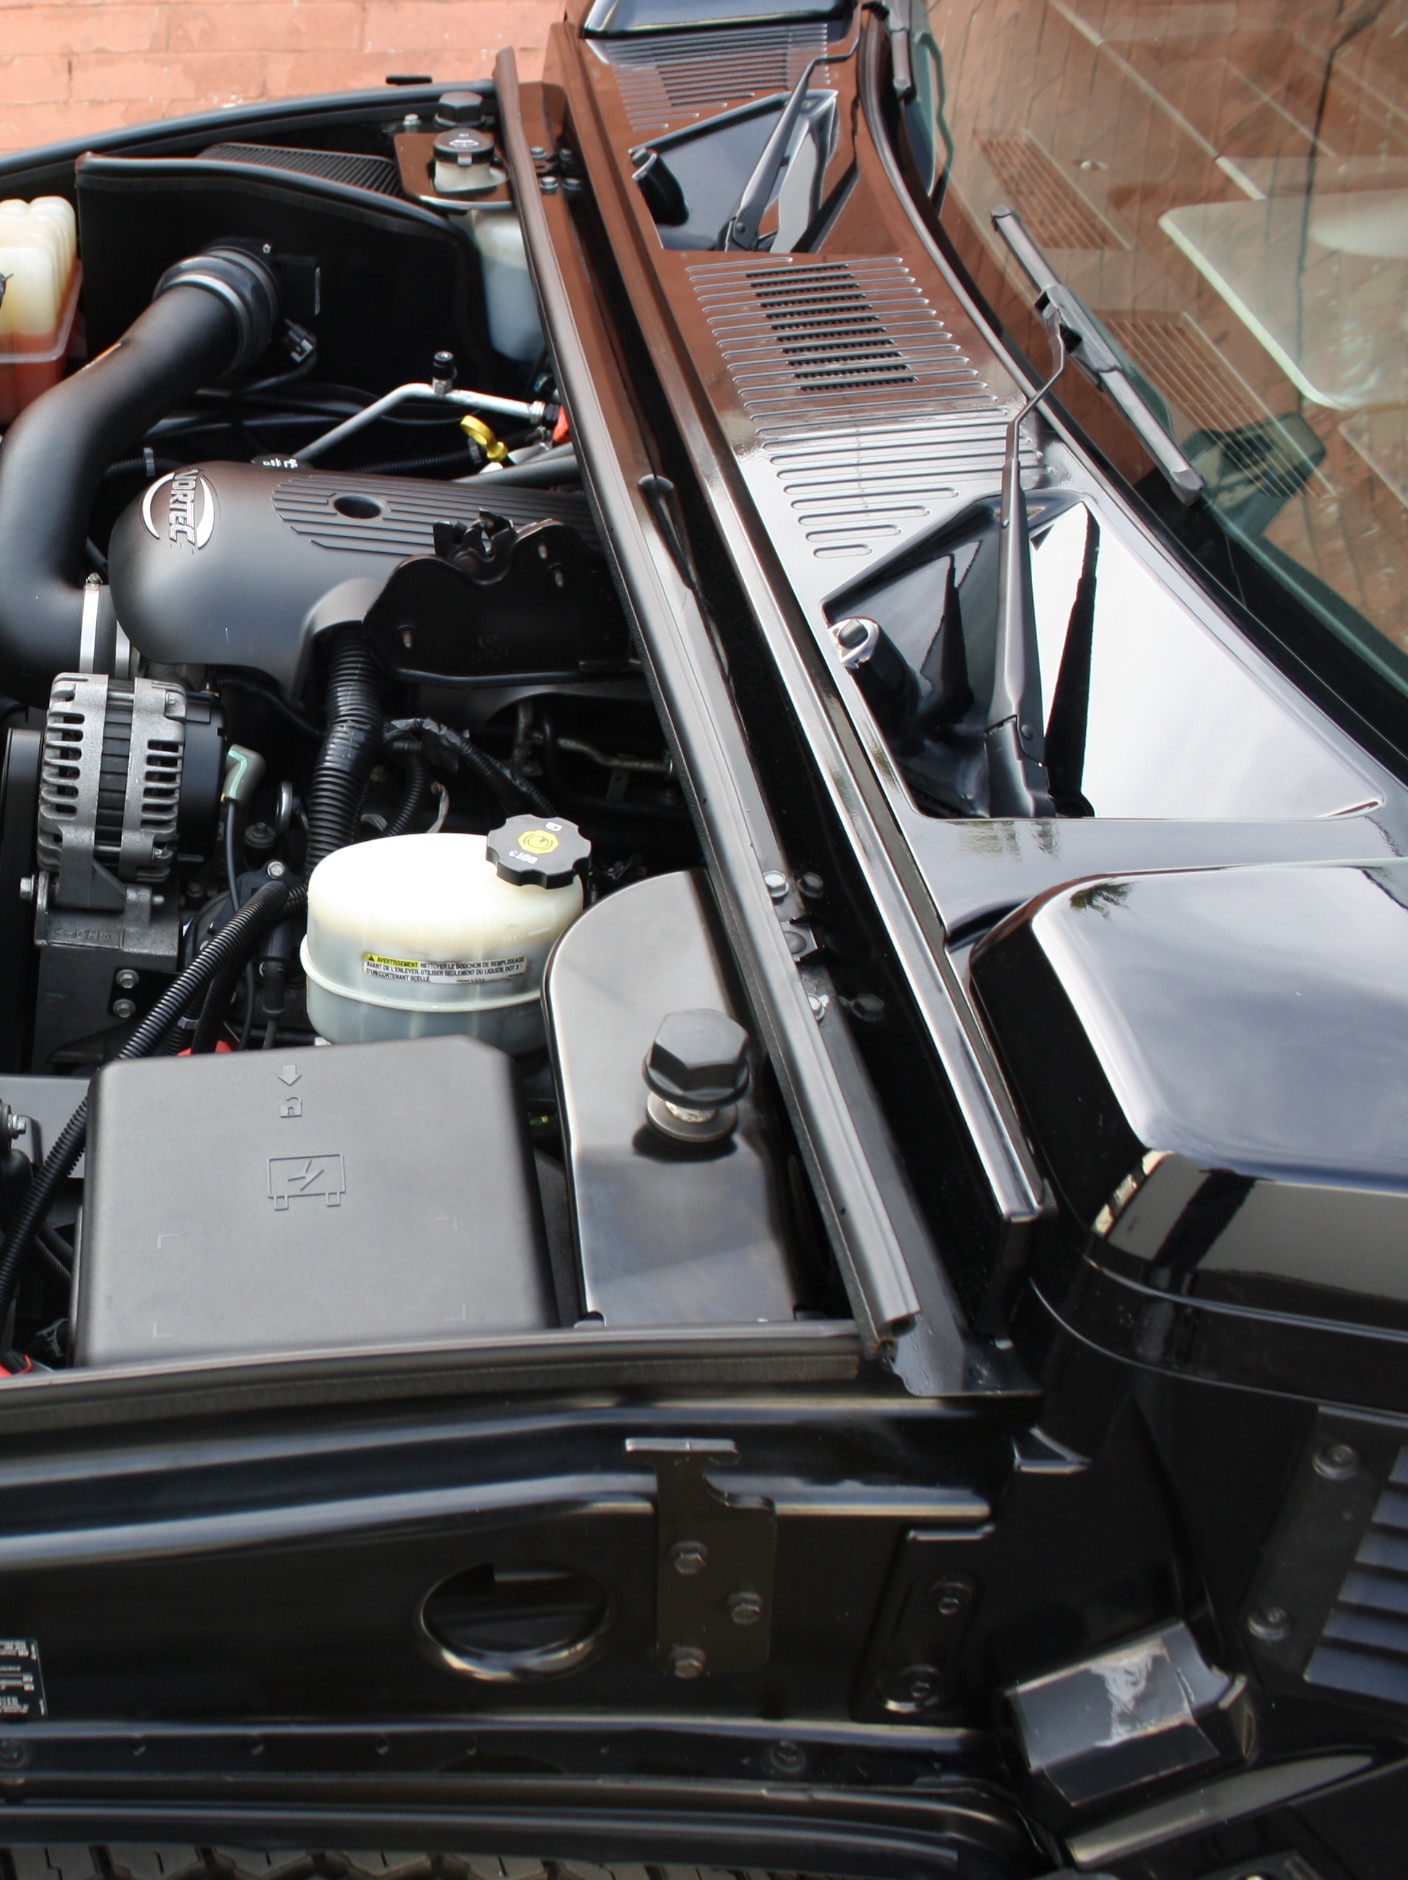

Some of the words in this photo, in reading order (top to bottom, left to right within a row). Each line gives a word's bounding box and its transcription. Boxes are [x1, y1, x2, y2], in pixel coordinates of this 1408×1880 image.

[168, 468, 198, 545] VORTEC
[515, 853, 538, 864] DOT
[367, 961, 382, 970] AVANT
[485, 967, 504, 975] LIQUIDE
[505, 965, 515, 973] DOT
[377, 956, 419, 968] AVERTISSEMENT
[420, 961, 447, 969] NETTOYER
[456, 961, 482, 969] BOUCHON
[491, 956, 525, 967] REMPLISSAGE
[379, 970, 409, 980] CONTENANT
